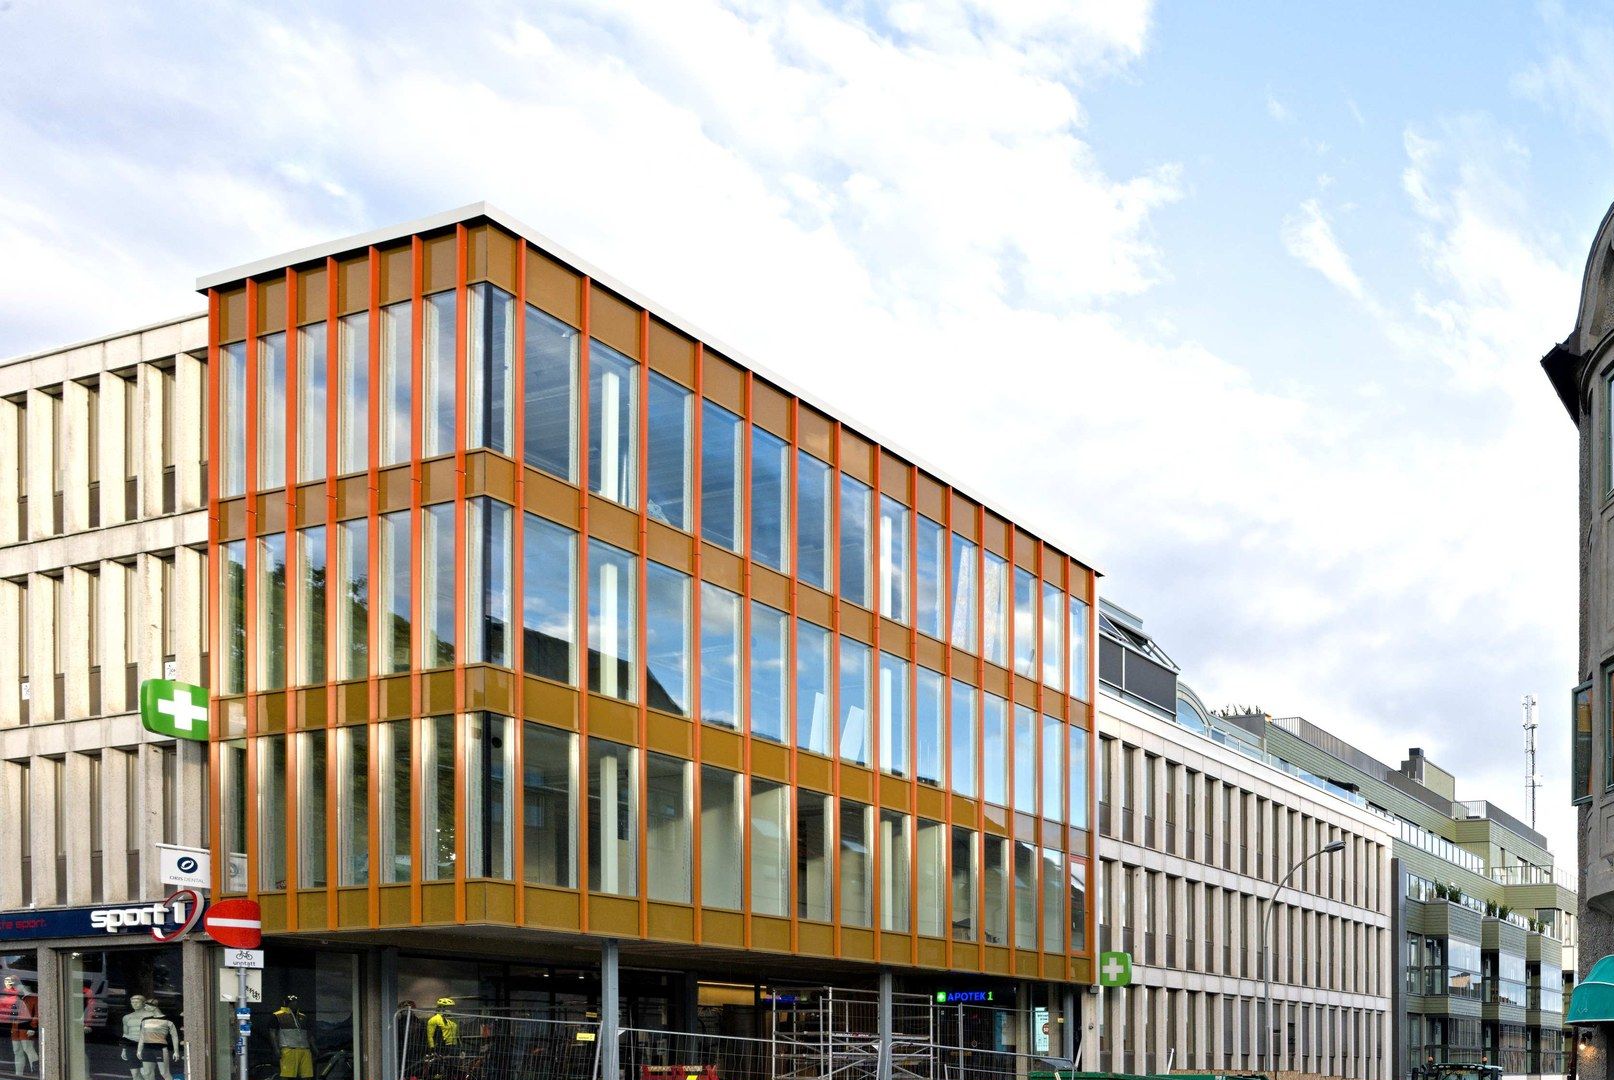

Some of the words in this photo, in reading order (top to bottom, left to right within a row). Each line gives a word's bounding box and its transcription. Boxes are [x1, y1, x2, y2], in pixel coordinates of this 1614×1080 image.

[91, 903, 169, 933] sport
[947, 991, 986, 1001] APOTEK
[987, 991, 994, 1001] 1
